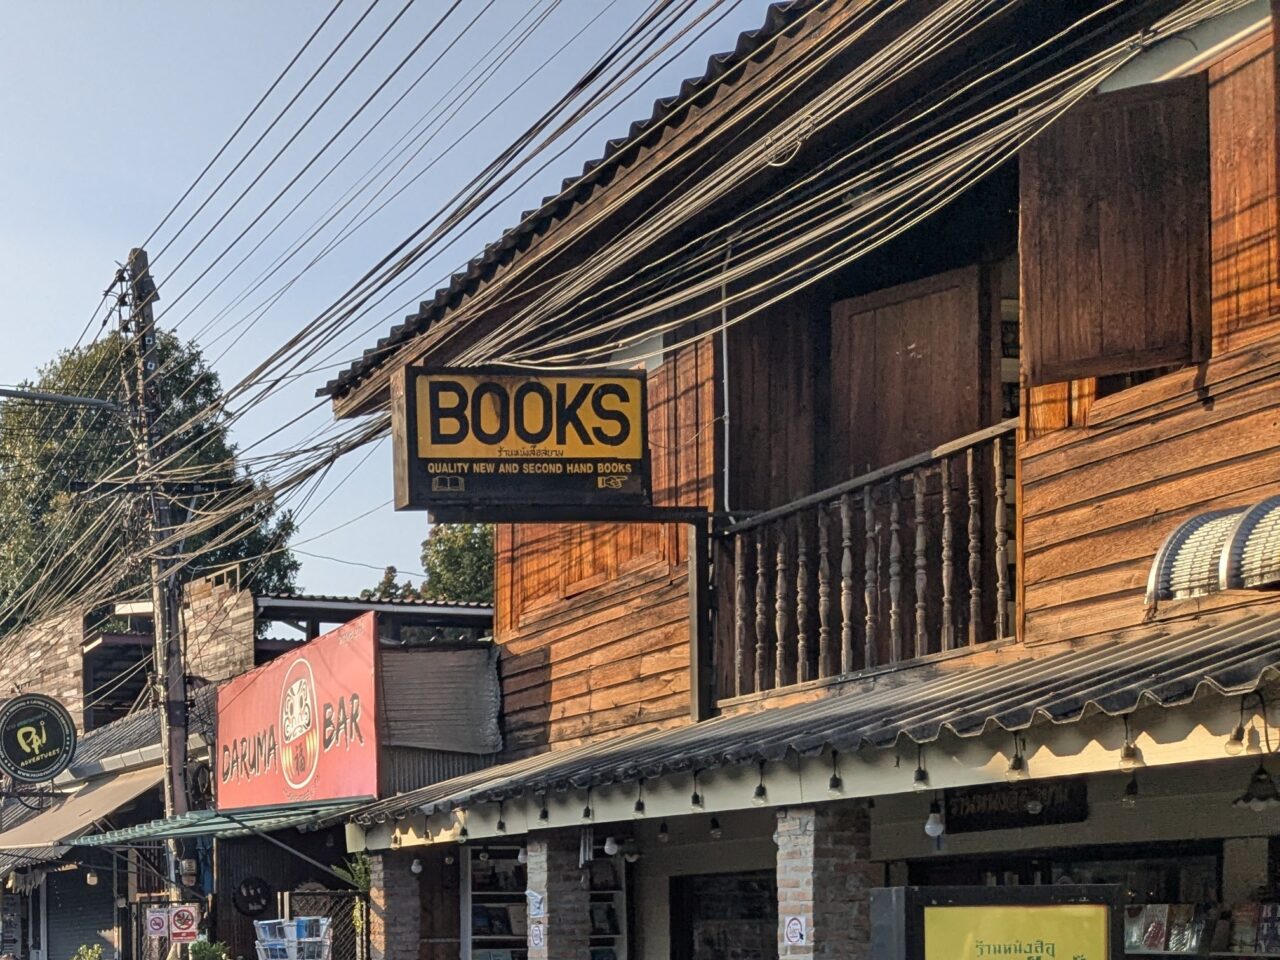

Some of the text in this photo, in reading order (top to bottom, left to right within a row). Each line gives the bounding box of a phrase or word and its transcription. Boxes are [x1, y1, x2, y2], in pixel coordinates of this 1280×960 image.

[428, 380, 631, 447] BOOKS
[427, 462, 632, 474] QUALITY NEW AND SECOND HAND BOOKS
[222, 693, 365, 785] DARUMA BAR
[975, 939, 1056, 959] ร้านหนังสือ
